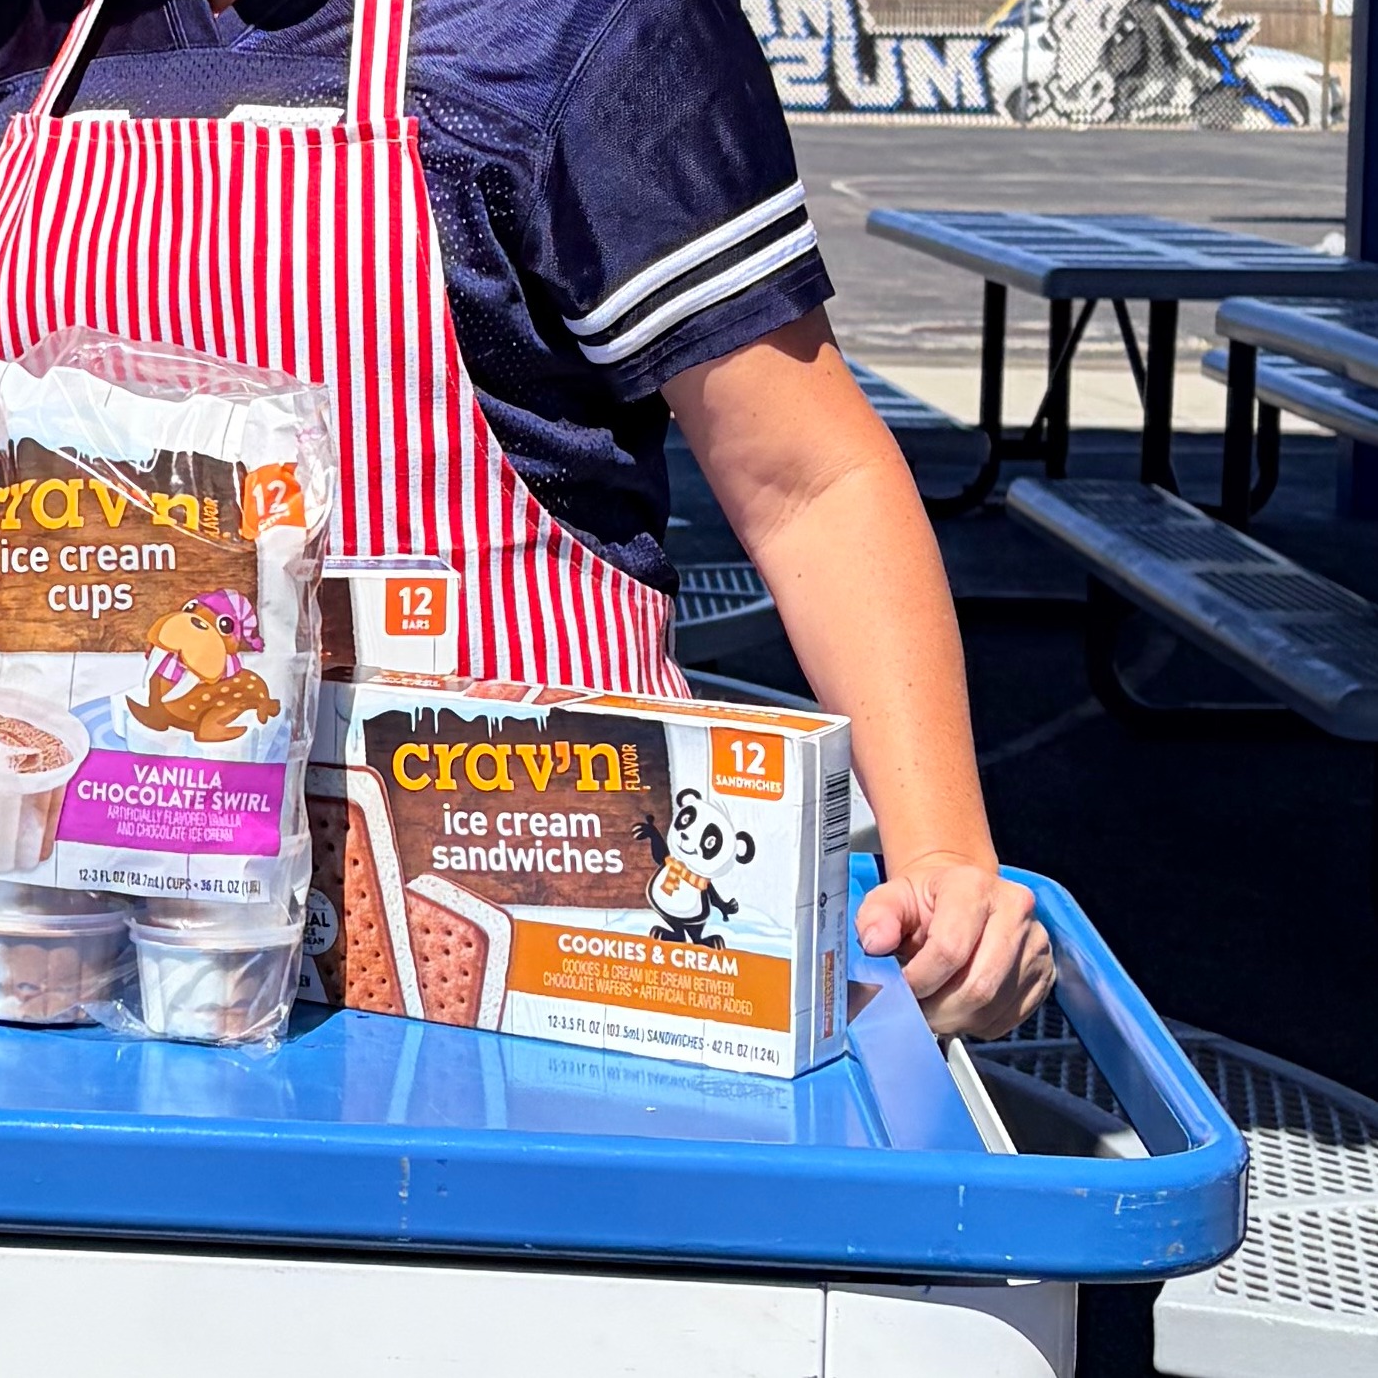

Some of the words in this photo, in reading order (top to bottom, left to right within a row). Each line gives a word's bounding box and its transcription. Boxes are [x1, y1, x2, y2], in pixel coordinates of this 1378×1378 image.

[253, 480, 289, 517] 12
[0, 539, 49, 573] ice
[59, 542, 176, 572] cream
[48, 583, 133, 619] cups
[398, 587, 432, 615] 12
[401, 619, 430, 631] BARS
[392, 741, 623, 792] crav'n
[623, 743, 641, 792] FLAVOR
[730, 740, 766, 775] 12
[133, 764, 222, 789] VANILLA
[715, 773, 782, 794] SANDWICHES
[78, 780, 204, 810] CHOCOLATE
[211, 792, 270, 812] SWIRL
[136, 824, 187, 841] CHOCOLATE
[442, 802, 488, 835] ice
[496, 810, 601, 838] cream
[432, 840, 624, 873] sandwiches
[166, 876, 192, 891] CUPS
[227, 880, 239, 893] OZ
[558, 933, 647, 963] COOKIES
[651, 945, 666, 965] &
[671, 948, 739, 977] CREAM
[543, 972, 593, 991] CHOCOLATE
[596, 978, 632, 997] WAFERS
[639, 985, 686, 1006] ARTIFICIAL
[688, 991, 722, 1010] FLAVOR
[724, 999, 753, 1016] ADDED
[562, 958, 601, 976] COOKIES
[611, 965, 642, 982] CREAM
[644, 969, 659, 983] ICE
[661, 970, 691, 988] CREAM
[693, 977, 734, 997] BETWEEN
[576, 1018, 586, 1033] FL
[589, 1020, 600, 1035] OZ
[647, 1030, 704, 1050] SANDWICHES
[724, 1041, 734, 1055] FL
[737, 1043, 748, 1057] OZ
